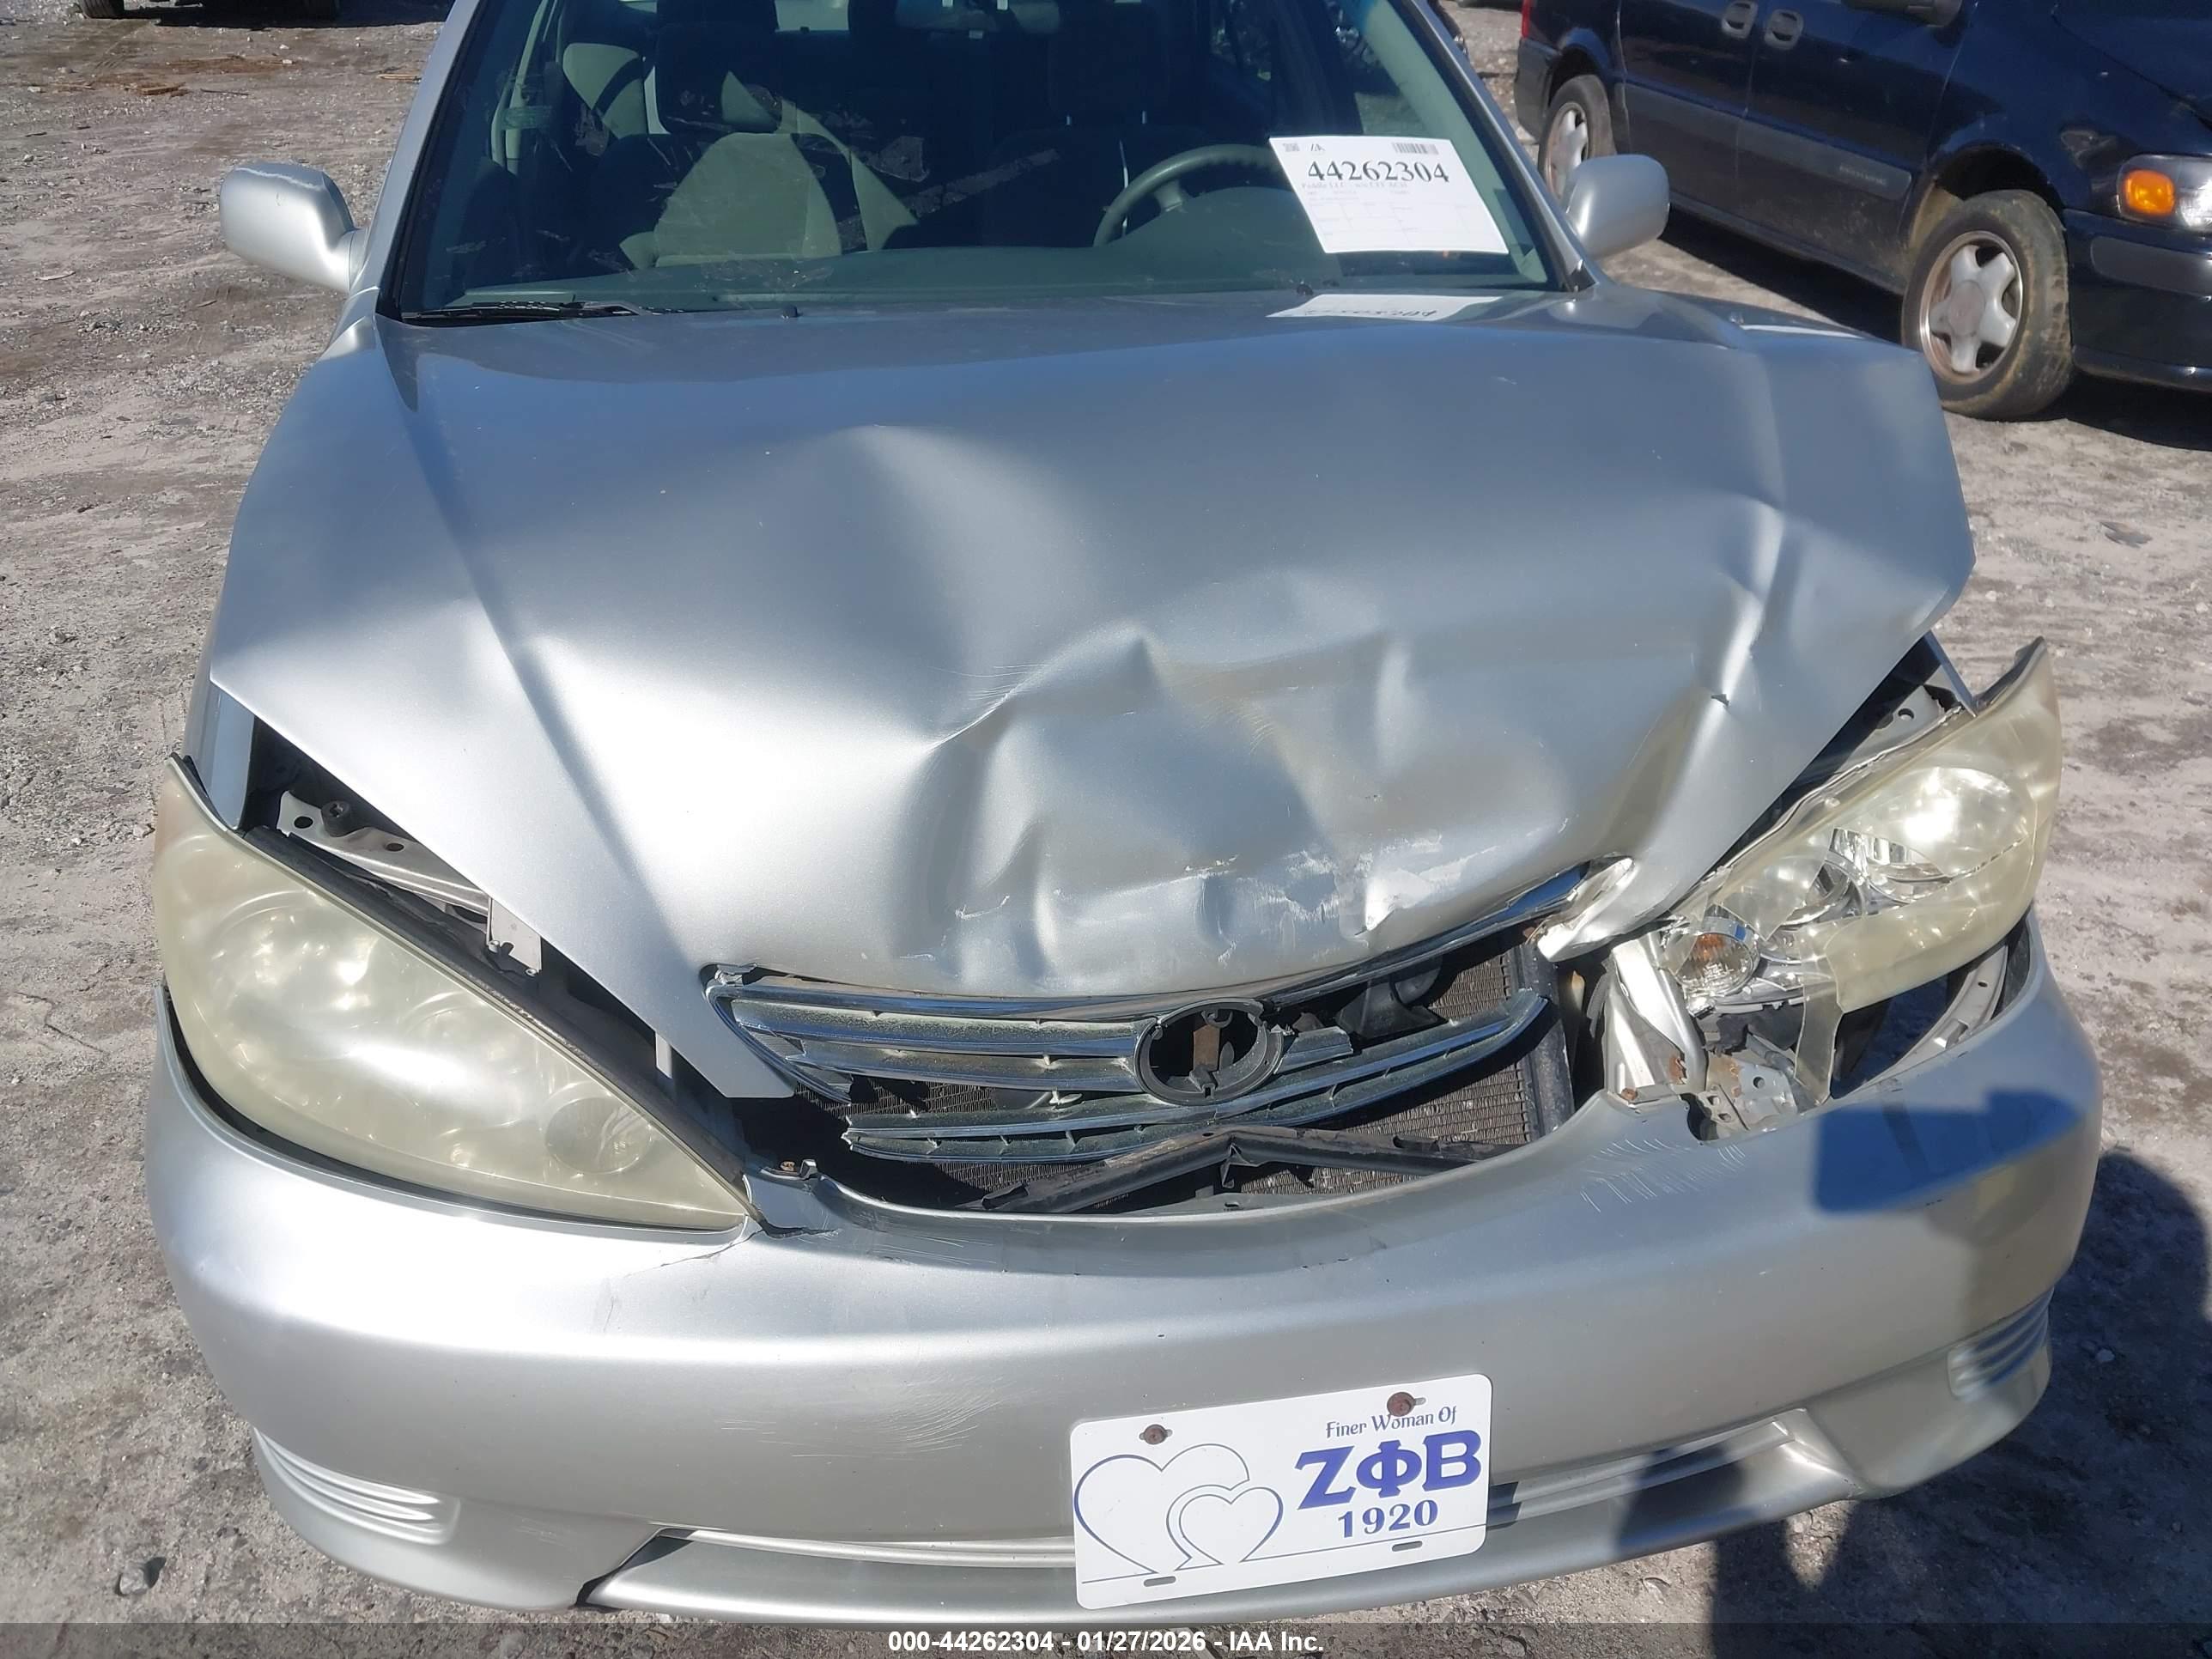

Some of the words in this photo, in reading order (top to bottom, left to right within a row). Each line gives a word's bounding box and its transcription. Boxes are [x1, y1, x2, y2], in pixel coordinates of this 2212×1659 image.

[1308, 161, 1449, 183] 44262304
[1325, 1420, 1367, 1439] Finer
[1371, 1413, 1434, 1431] Woman
[1438, 1405, 1457, 1425] Of
[1338, 1499, 1438, 1538] 1920
